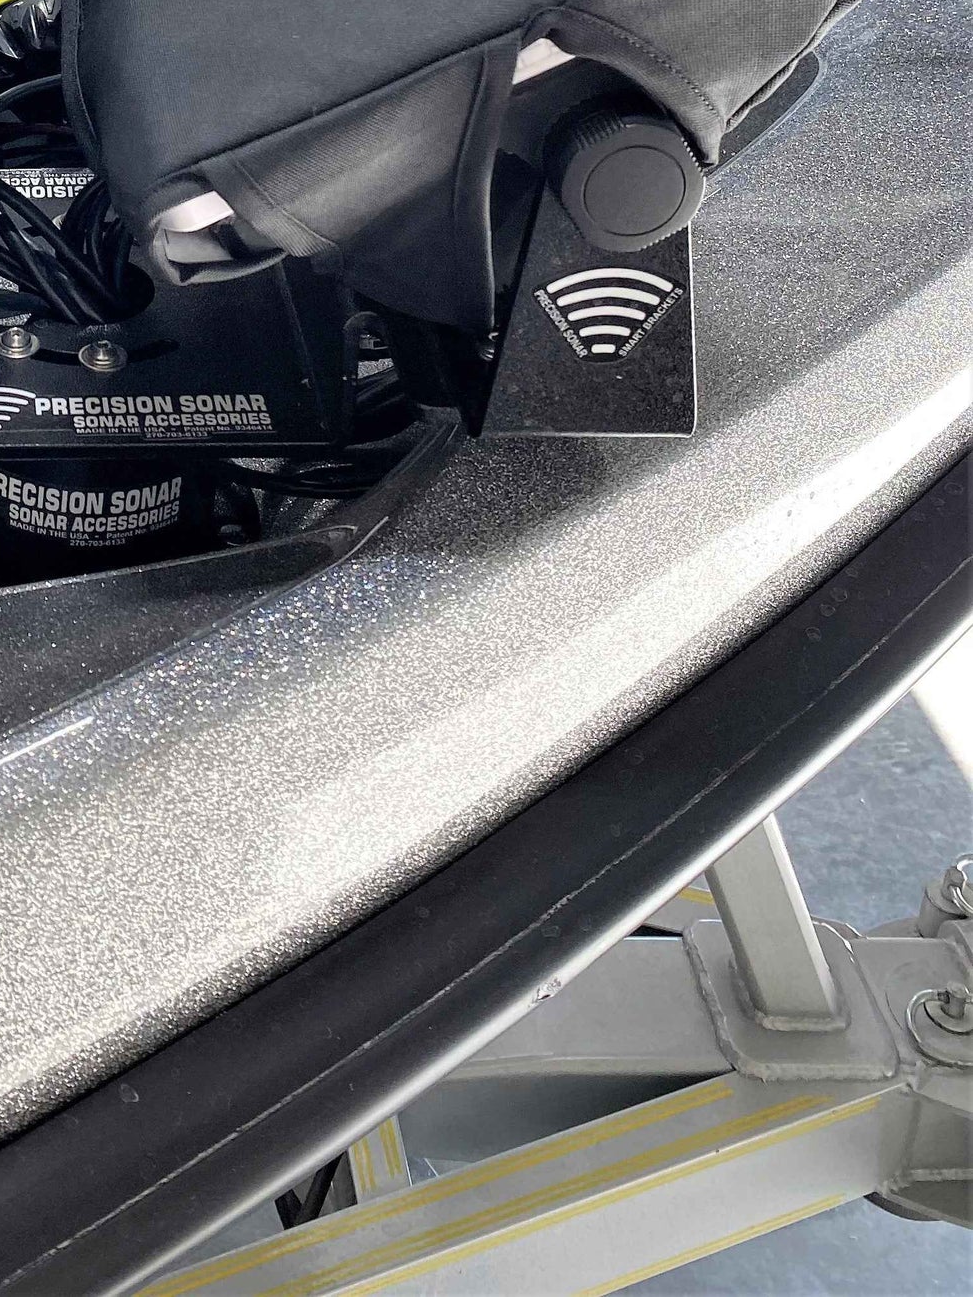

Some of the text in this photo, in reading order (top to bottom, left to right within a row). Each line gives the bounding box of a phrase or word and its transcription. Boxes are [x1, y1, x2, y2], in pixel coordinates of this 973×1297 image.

[15, 185, 84, 199] CISION
[534, 289, 588, 358] PRECISION SONAR
[618, 287, 684, 358] SMART BRACKETS
[34, 393, 268, 417] PRECISION SONAR
[73, 412, 272, 429] SONAR ACCESSORIES
[183, 425, 214, 433] Patent
[109, 475, 182, 515] SONAR
[8, 500, 180, 534] SONAR ACCESSORIES
[9, 519, 35, 534] MADE
[37, 527, 47, 536] IN
[49, 529, 68, 539] THE
[69, 532, 90, 540] USA
[106, 529, 134, 540] Patent
[69, 538, 127, 547] 270-703-6133
